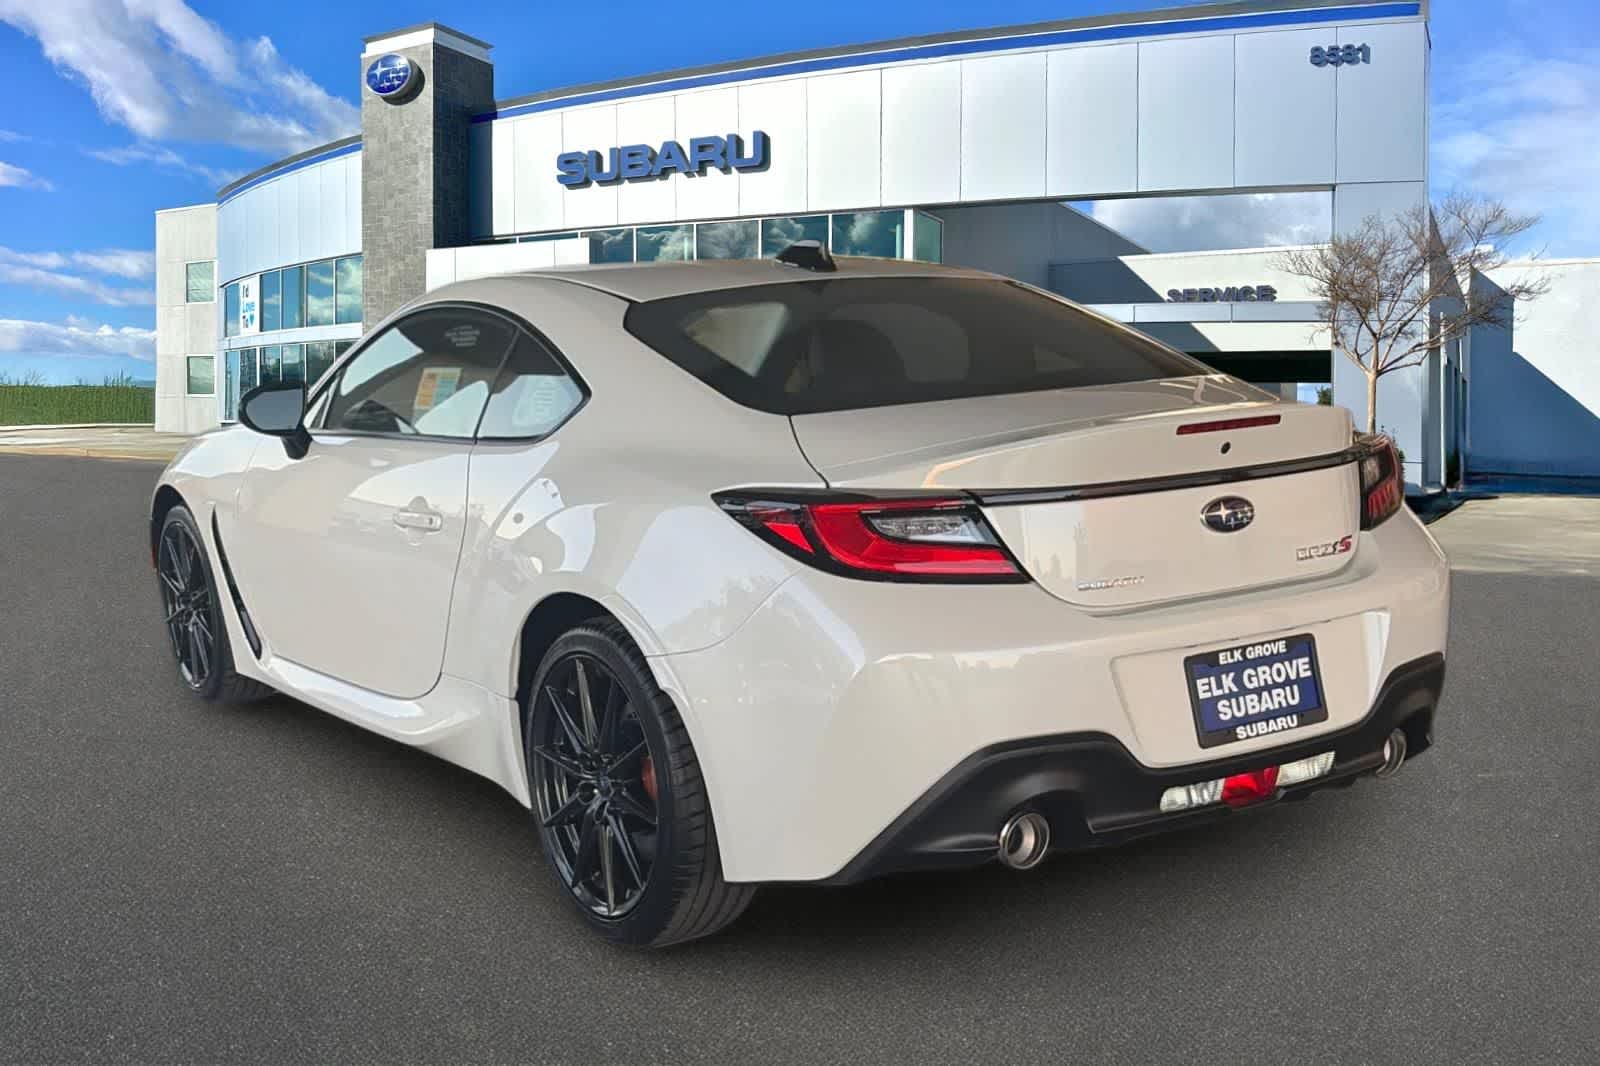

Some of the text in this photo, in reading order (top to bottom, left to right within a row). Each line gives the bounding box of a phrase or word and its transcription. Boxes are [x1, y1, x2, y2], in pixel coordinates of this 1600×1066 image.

[556, 130, 771, 190] SUBARU
[1167, 285, 1277, 302] SERVICE
[1218, 640, 1287, 665] ELK GROVE
[1196, 657, 1312, 699] ELK GROVE
[1217, 684, 1300, 721] SUBARU
[1235, 714, 1298, 739] SUBARU
